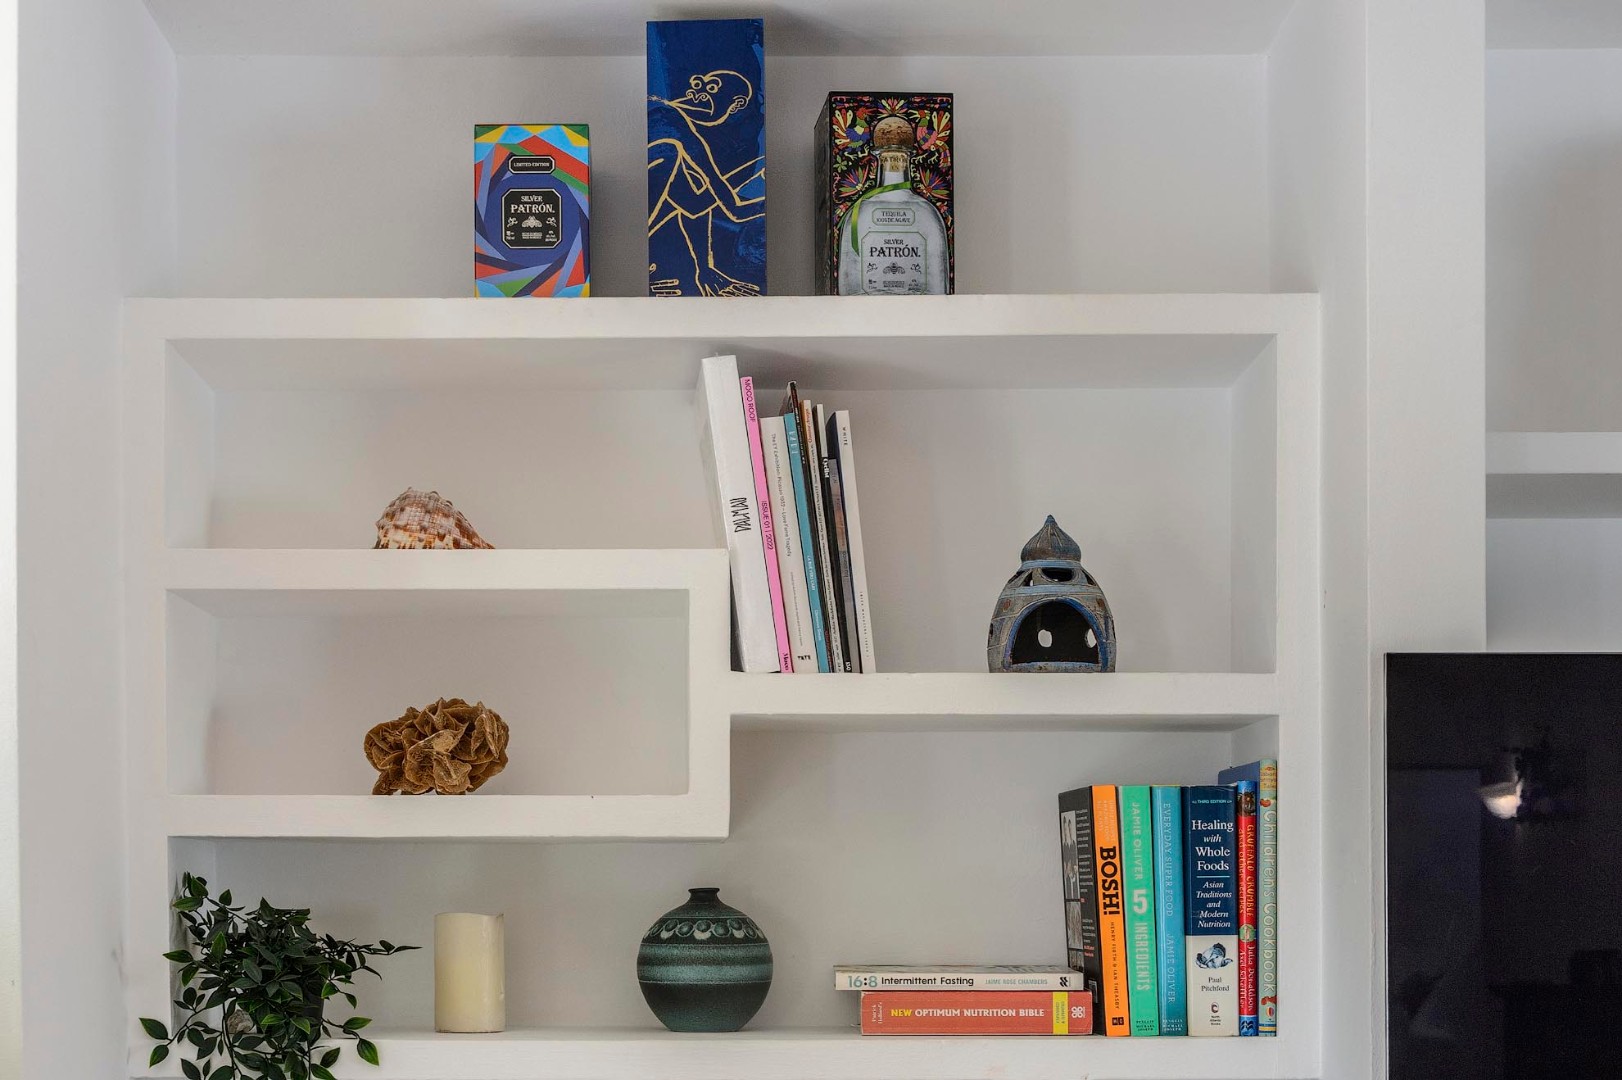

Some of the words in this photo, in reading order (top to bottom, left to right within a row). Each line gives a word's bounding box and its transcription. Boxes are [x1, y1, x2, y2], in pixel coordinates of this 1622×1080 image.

[744, 380, 753, 402] MOCO
[761, 501, 770, 520] ISSUE
[763, 521, 771, 530] 01
[765, 534, 774, 550] 2022
[784, 538, 793, 557] Tragedy
[1132, 802, 1142, 836] JAMIE
[1163, 803, 1172, 854] EVERYDAY
[1192, 820, 1233, 832] Healing
[1195, 847, 1230, 856] Whole
[1203, 834, 1221, 842] with
[1246, 824, 1254, 871] GRUFFALO
[1134, 839, 1143, 880] OLIVER
[1197, 861, 1229, 870] Foods
[1263, 811, 1276, 897] Childrens
[1100, 846, 1120, 916] BOSH!
[1164, 856, 1172, 887] SUPER
[1132, 889, 1147, 913] 5
[1246, 876, 1254, 917] CRUMBLE
[1135, 922, 1151, 990] INGREDIENTS
[1166, 934, 1175, 964] JAMIE
[1263, 903, 1276, 991] Cookbook
[848, 976, 878, 988] 16:8
[881, 977, 937, 985] Intermittent
[940, 977, 974, 986] Fasting
[1168, 967, 1176, 1003] OLIVER
[1247, 968, 1255, 1010] Donaldson
